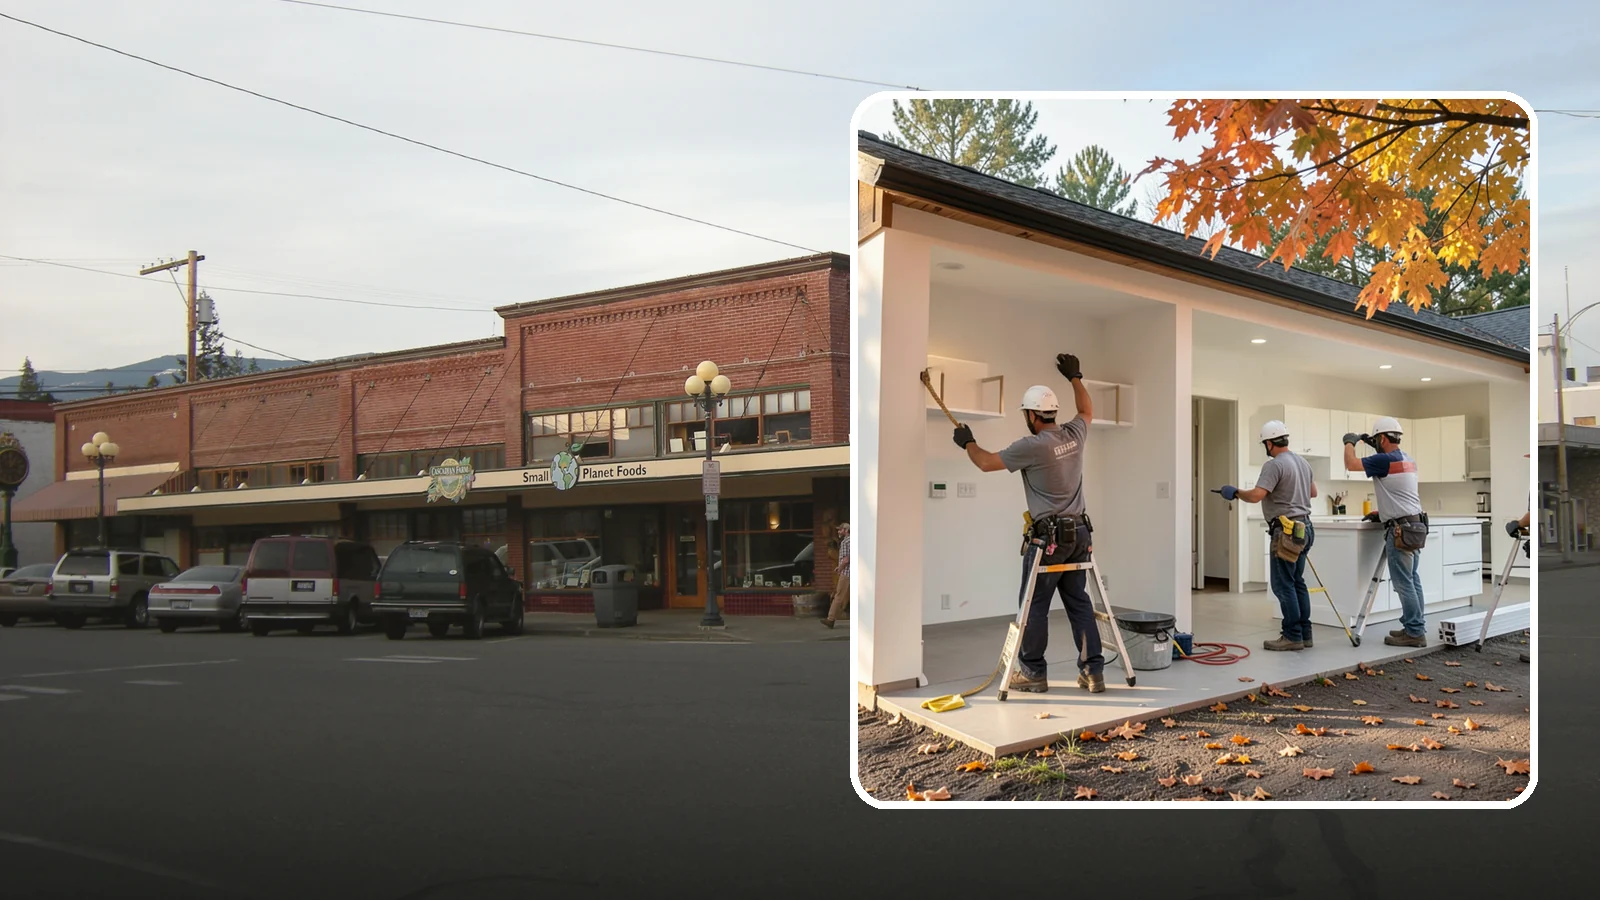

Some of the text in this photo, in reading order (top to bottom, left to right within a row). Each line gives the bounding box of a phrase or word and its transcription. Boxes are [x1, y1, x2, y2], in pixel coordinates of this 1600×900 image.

[523, 464, 647, 483] Small Planet Foods
